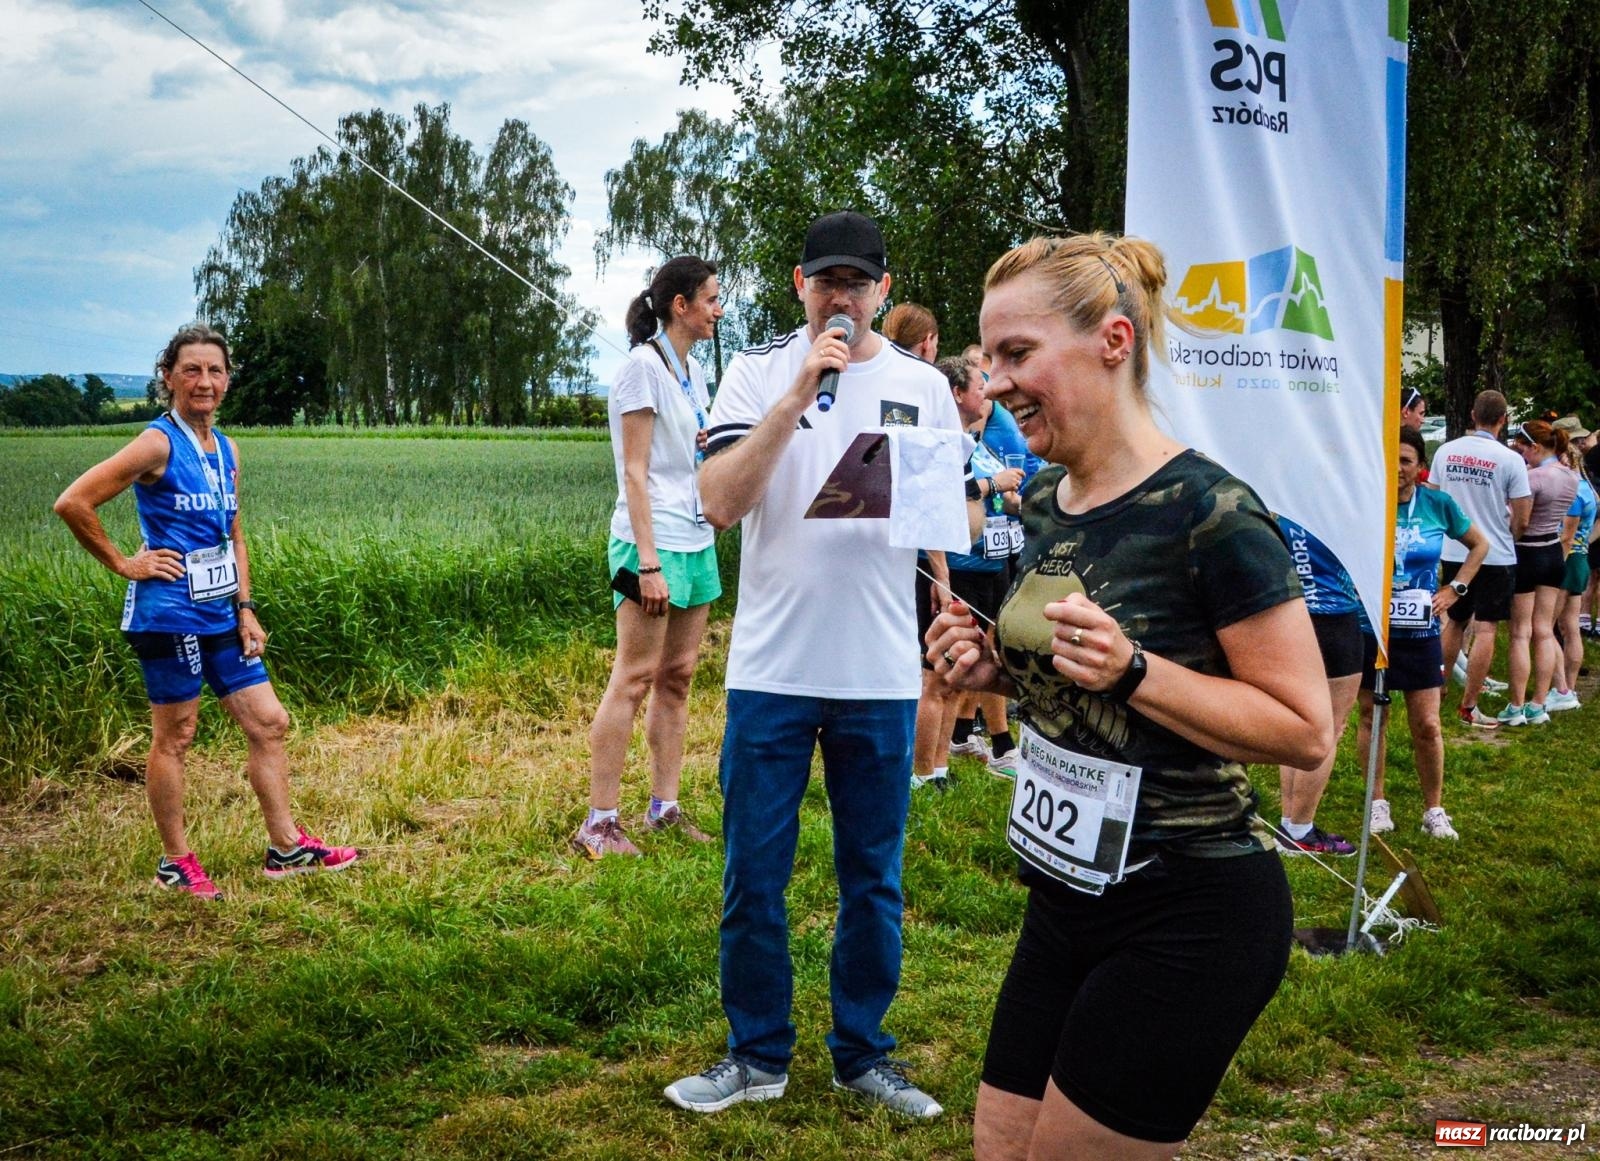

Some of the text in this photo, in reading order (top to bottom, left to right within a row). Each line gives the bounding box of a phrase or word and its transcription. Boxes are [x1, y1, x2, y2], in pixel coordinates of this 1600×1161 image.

[1446, 464, 1495, 480] KATOWICE
[207, 564, 228, 585] 171
[1039, 559, 1073, 576] HERO
[1030, 742, 1046, 761] BIEG
[1045, 753, 1058, 769] NA
[1059, 759, 1106, 785] PIĄTKĘ
[1020, 779, 1079, 846] 202
